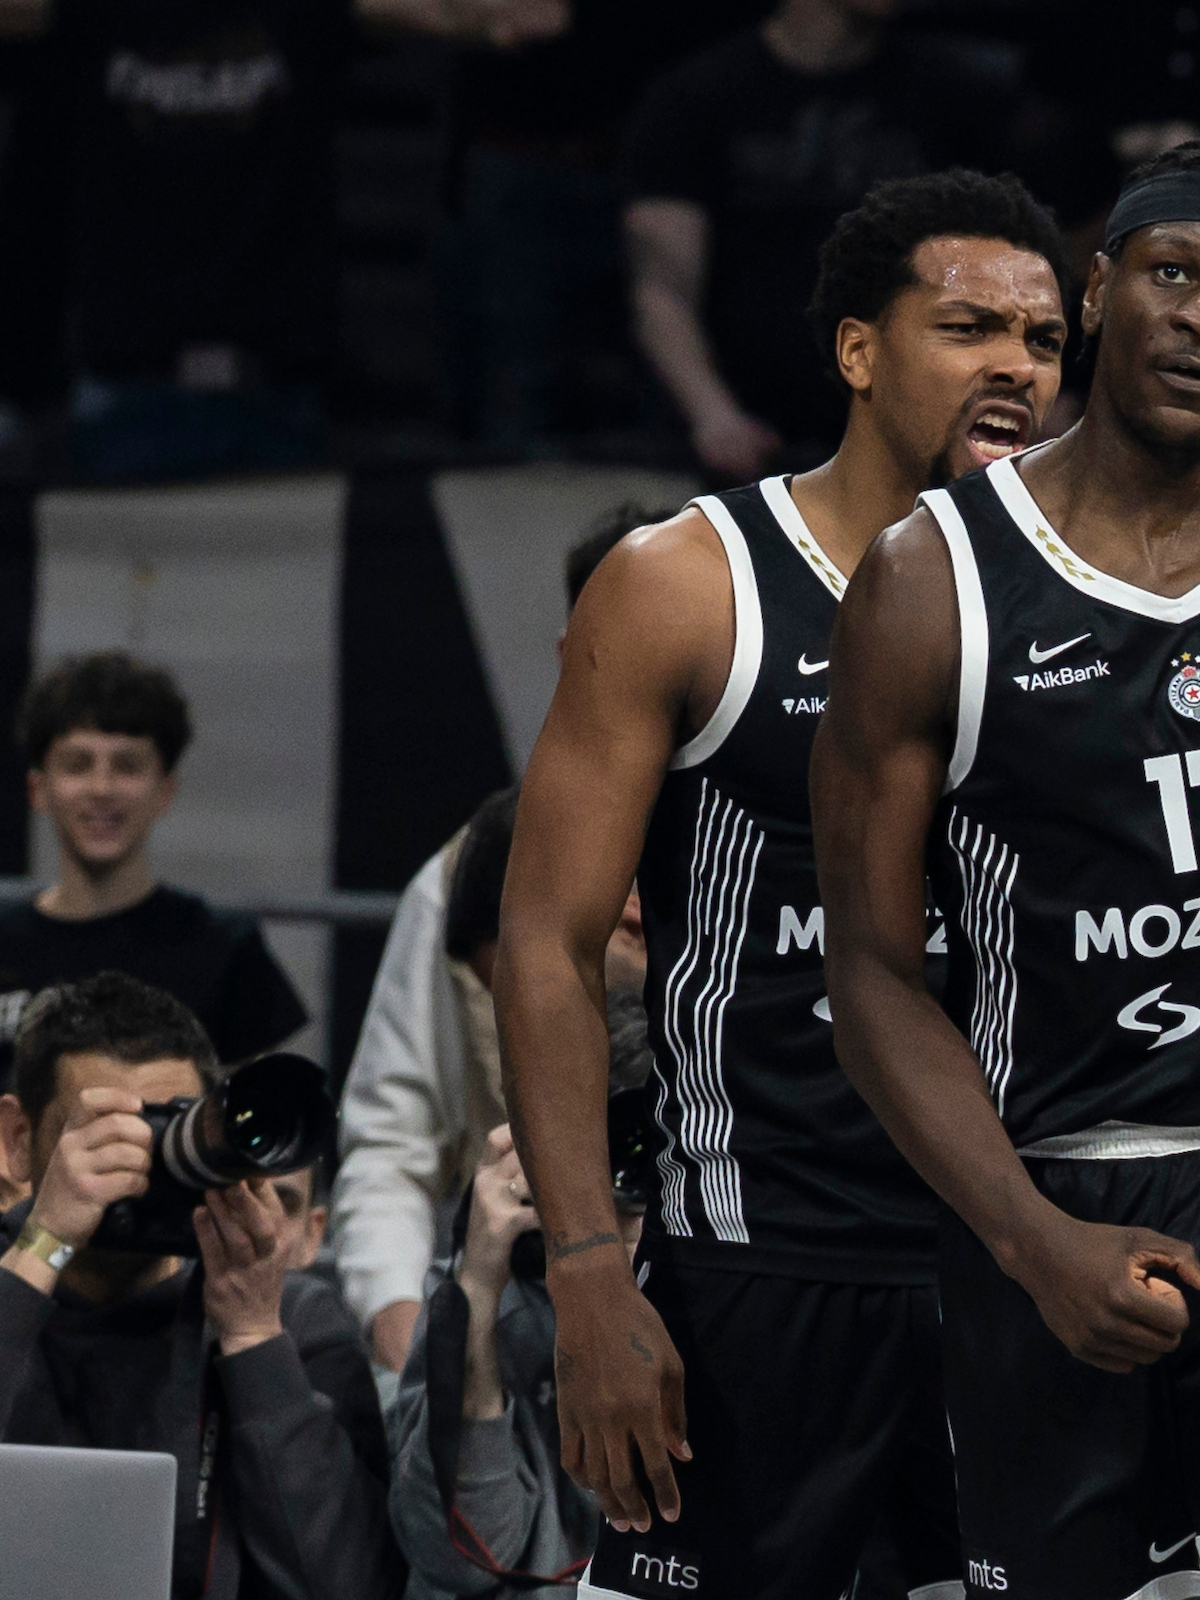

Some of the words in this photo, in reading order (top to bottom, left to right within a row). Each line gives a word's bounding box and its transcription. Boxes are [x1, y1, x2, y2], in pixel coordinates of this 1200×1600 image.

[1031, 660, 1111, 691] AikBank
[631, 1552, 700, 1590] mts
[968, 1558, 1008, 1591] mts
